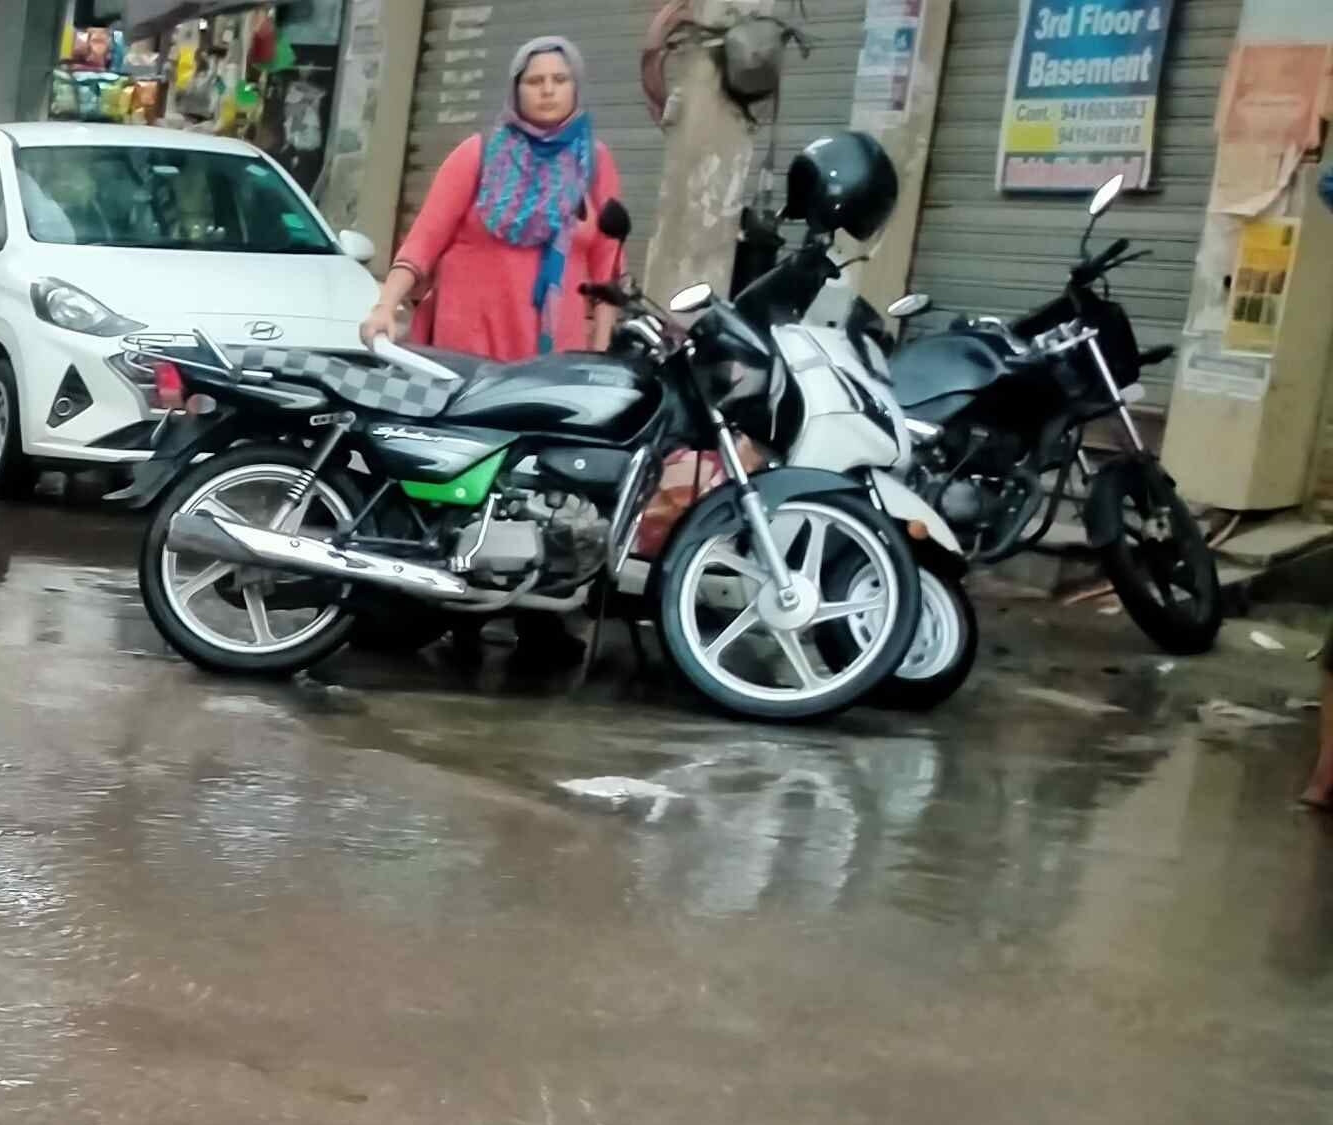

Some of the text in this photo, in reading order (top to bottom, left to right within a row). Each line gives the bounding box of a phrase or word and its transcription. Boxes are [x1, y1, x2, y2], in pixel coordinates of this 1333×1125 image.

[1034, 7, 1074, 40] 3rd
[1077, 4, 1146, 36] Floor
[1027, 47, 1153, 88] Basement
